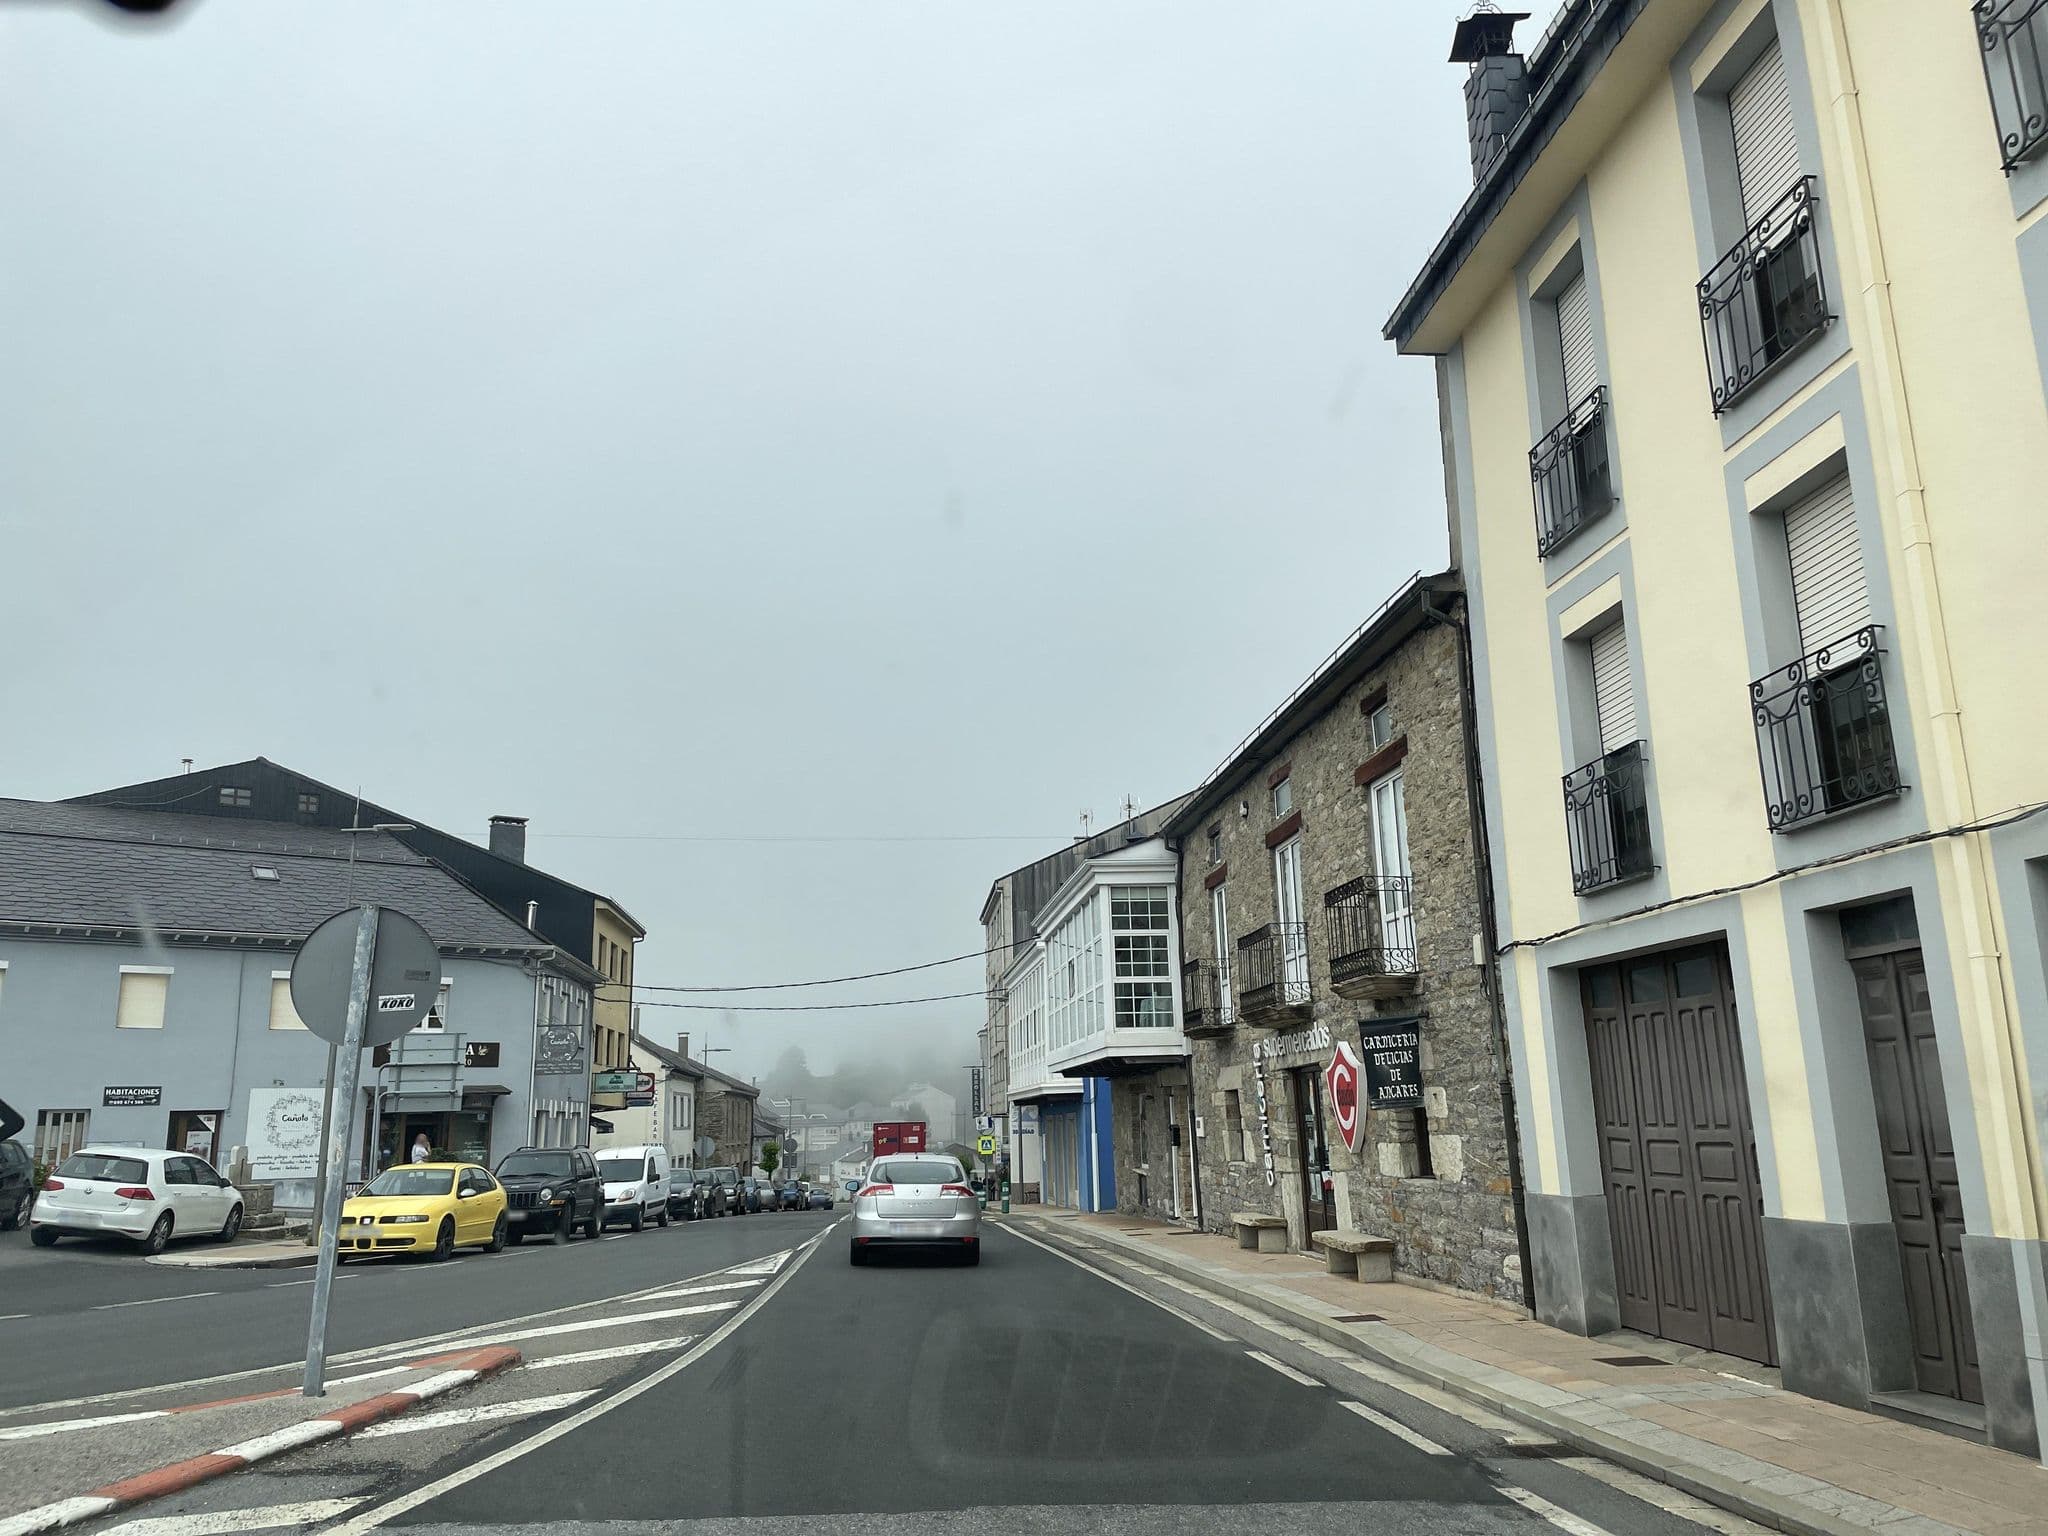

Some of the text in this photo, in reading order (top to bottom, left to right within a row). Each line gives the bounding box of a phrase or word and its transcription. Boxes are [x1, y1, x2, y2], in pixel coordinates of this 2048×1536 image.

[380, 998, 414, 1010] KOKO
[1262, 1022, 1330, 1057] supermercados
[1373, 1050, 1414, 1066] DELICIAS
[1389, 1068, 1402, 1082] DE
[105, 1088, 160, 1096] HABITACIONES
